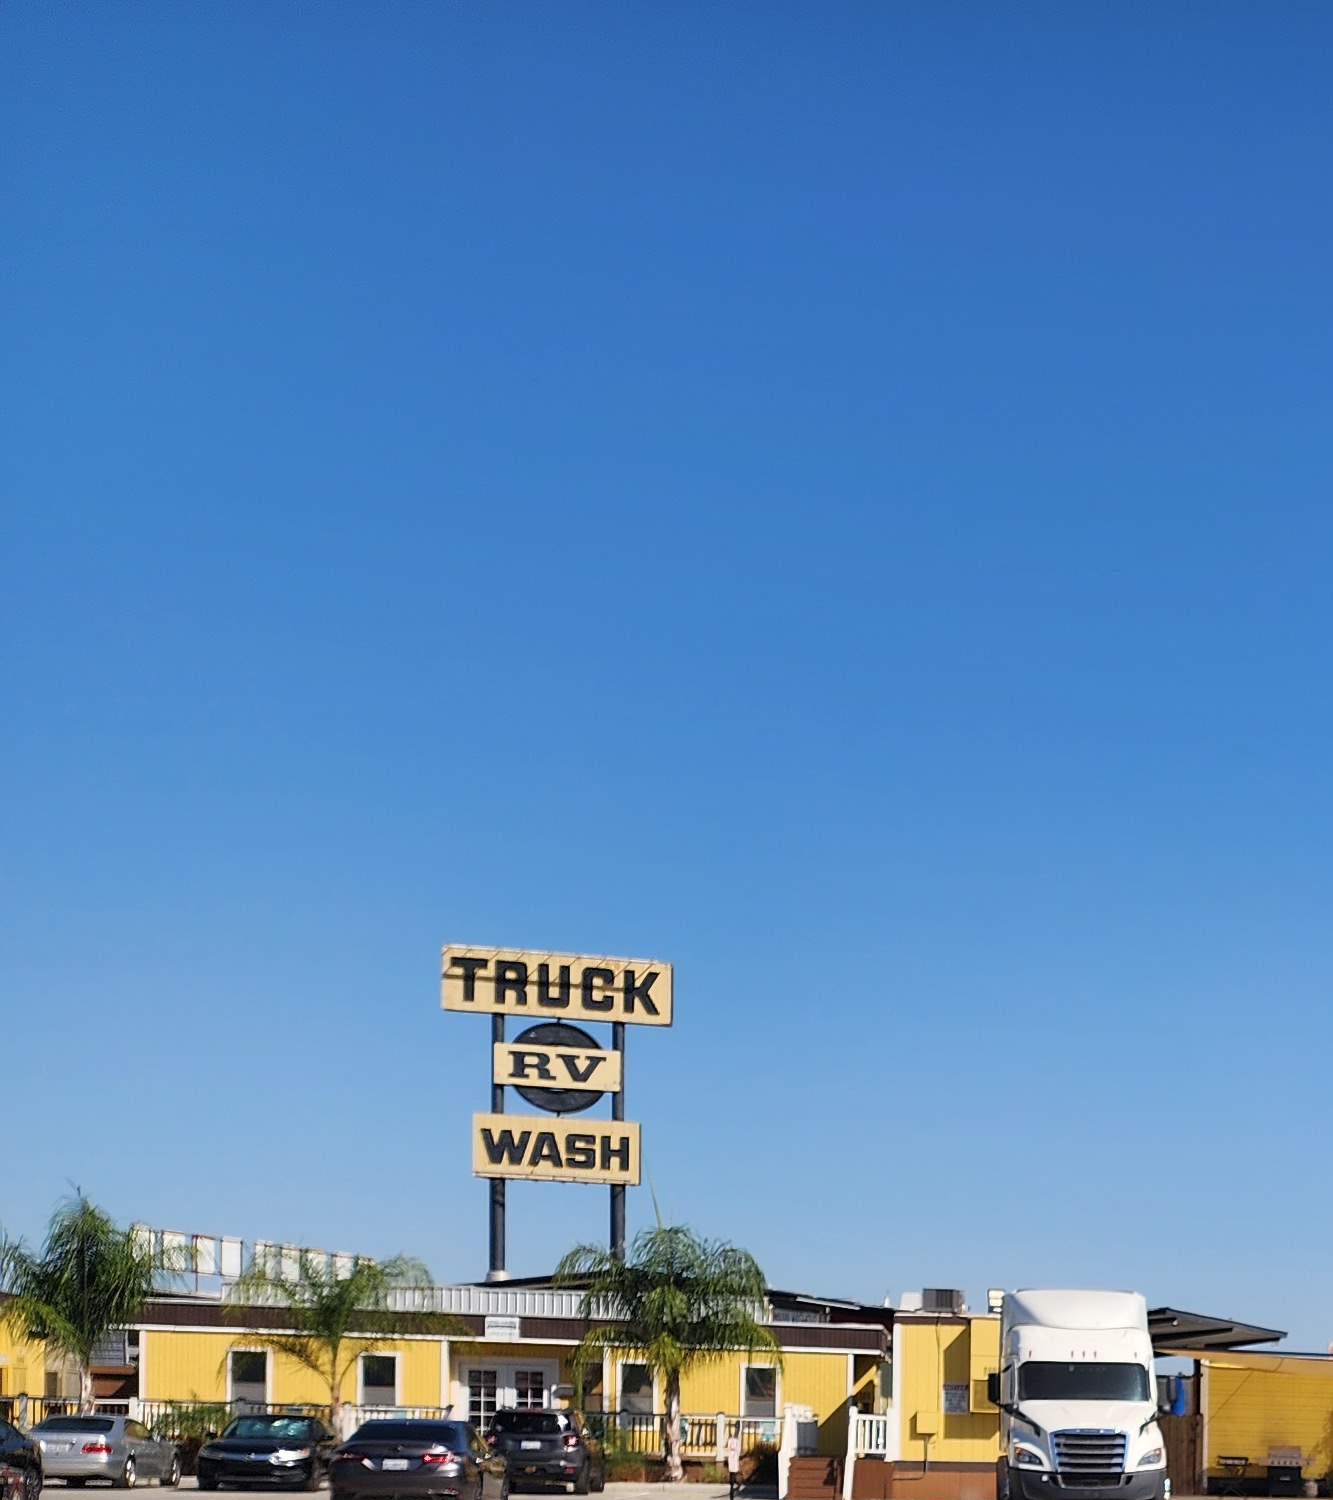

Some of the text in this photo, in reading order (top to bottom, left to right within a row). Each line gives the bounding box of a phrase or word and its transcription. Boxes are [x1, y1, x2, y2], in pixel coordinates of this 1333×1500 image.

[451, 957, 660, 1015] TRUCK
[507, 1051, 607, 1083] RV
[481, 1128, 629, 1171] WASH
